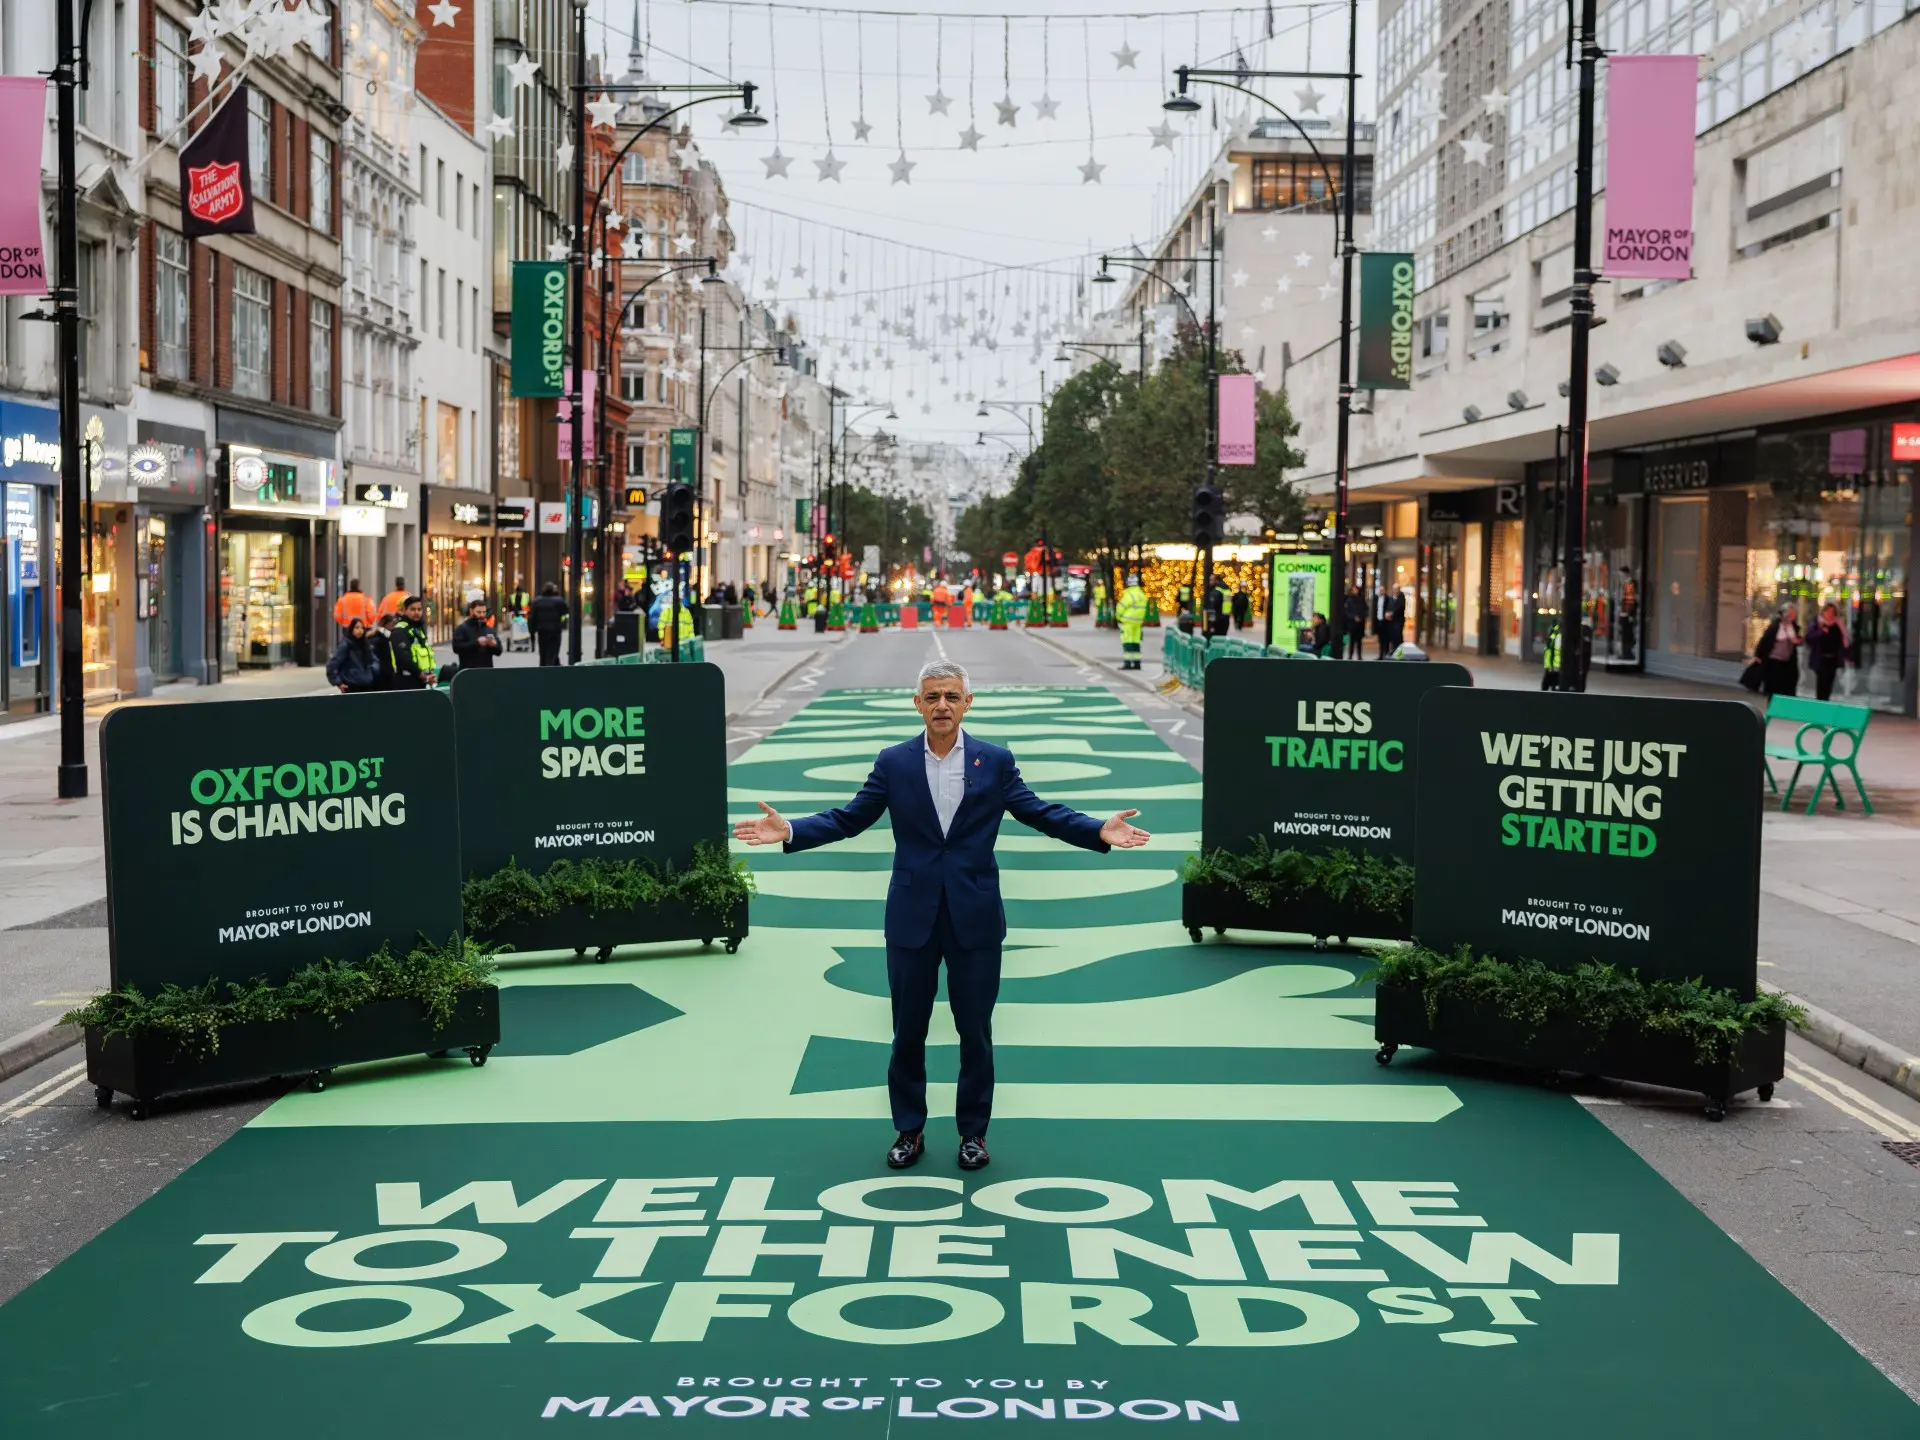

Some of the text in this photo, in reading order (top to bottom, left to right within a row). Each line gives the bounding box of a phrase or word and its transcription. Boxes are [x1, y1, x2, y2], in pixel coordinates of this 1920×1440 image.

[192, 170, 237, 209] SALVATION
[199, 169, 218, 188] THE
[208, 188, 235, 216] ARMY
[24, 247, 39, 257] OF
[1608, 228, 1688, 244] MAYOR OF
[1607, 245, 1689, 262] LONDON
[543, 270, 565, 371] OXFORD
[1390, 261, 1413, 363] OXFORD
[1645, 461, 1709, 490] RESERVED
[1278, 564, 1326, 573] COMING
[540, 706, 646, 740] MORE
[1297, 700, 1373, 734] LESS
[540, 743, 646, 779] SPACE
[1264, 735, 1404, 772] TRAFFIC
[1480, 731, 1687, 781] WE'RE JUST
[190, 760, 357, 805] OXFORD
[1498, 774, 1662, 820] GETTING
[171, 792, 406, 846] IS CHANGING
[556, 822, 591, 831] BROUGHT
[1273, 821, 1391, 839] MAYOR OF LONDON
[1294, 812, 1329, 820] BROUGHT
[1331, 813, 1342, 821] TO
[535, 830, 655, 849] MAYOR OF LONDON
[1501, 812, 1657, 858] STARTED
[246, 900, 345, 919] BROUGHT TO YOU BY
[1527, 897, 1624, 916] BROUGHT TO YOU BY
[219, 911, 372, 944] MAYOR OF LONDON
[1502, 909, 1650, 941] MAYOR OF LONDON
[375, 1176, 1488, 1226] WELCOME
[192, 1225, 1621, 1285] TO THE NEW
[241, 1281, 1360, 1348] OXFORD
[676, 1376, 1109, 1390] BROUGHT TO YOU BY
[541, 1395, 1240, 1422] MAYOR OF LONDON
